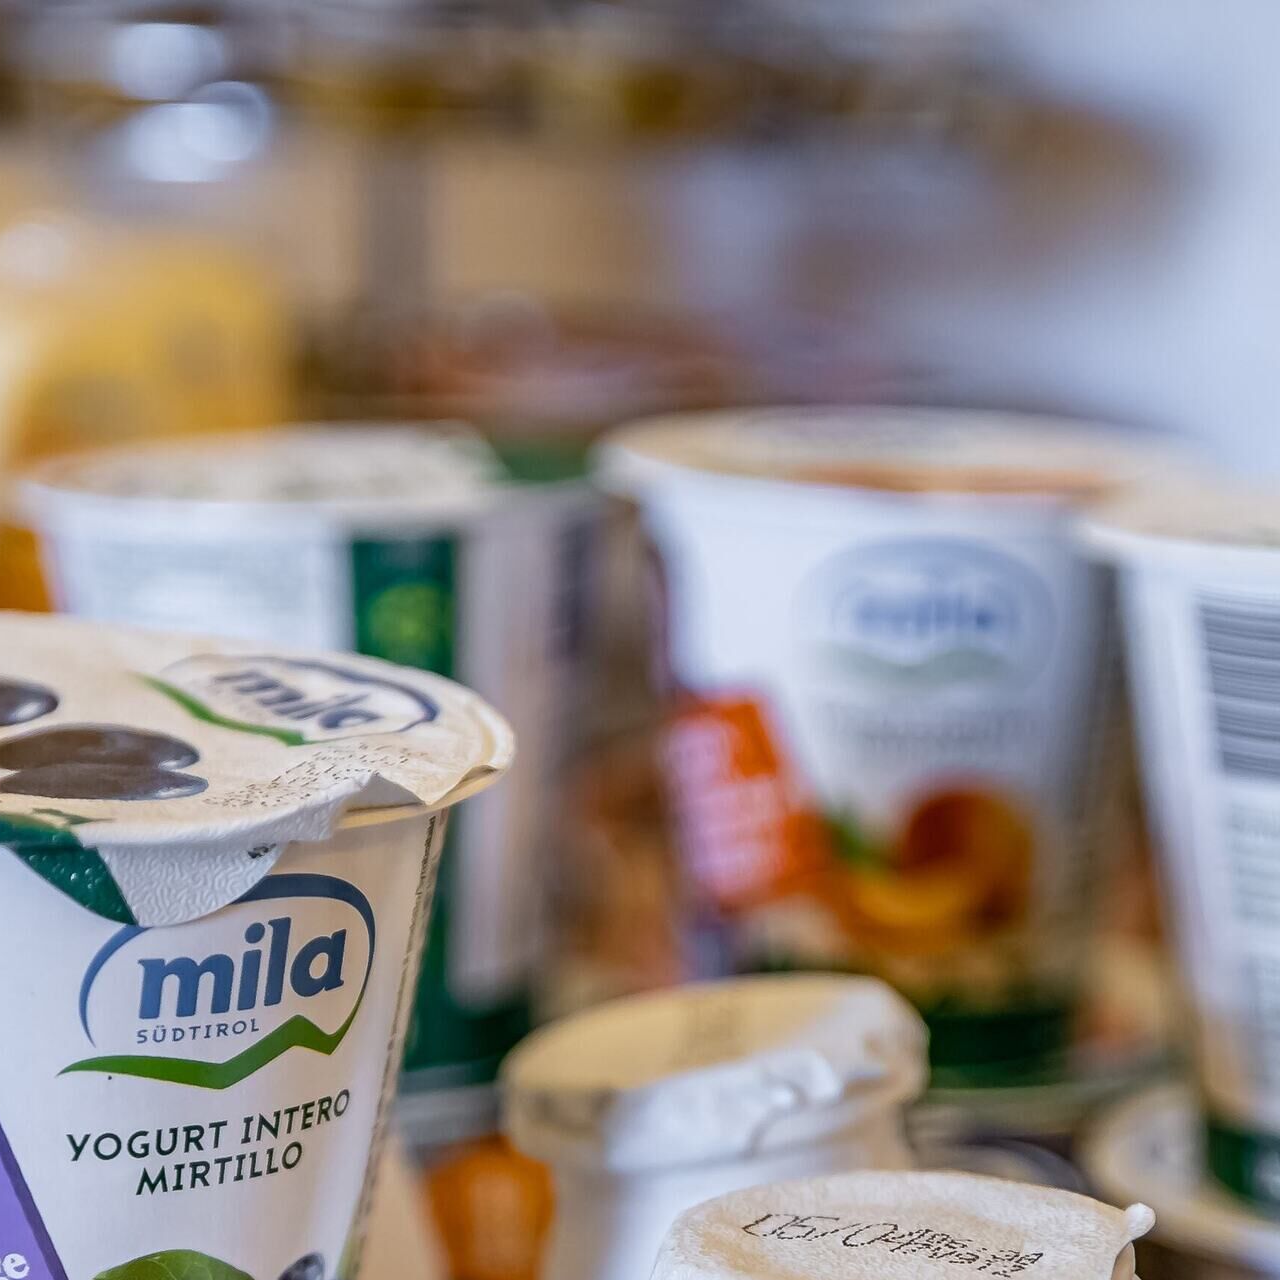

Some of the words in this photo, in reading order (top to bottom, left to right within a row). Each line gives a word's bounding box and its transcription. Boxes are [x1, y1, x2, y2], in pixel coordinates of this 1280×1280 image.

[211, 672, 382, 730] mila
[138, 916, 346, 1019] mila
[136, 1017, 260, 1045] SÜDTIROL
[67, 1119, 229, 1163] YOGURT
[241, 1088, 351, 1145] INTERO
[135, 1140, 304, 1196] MIRTILLO
